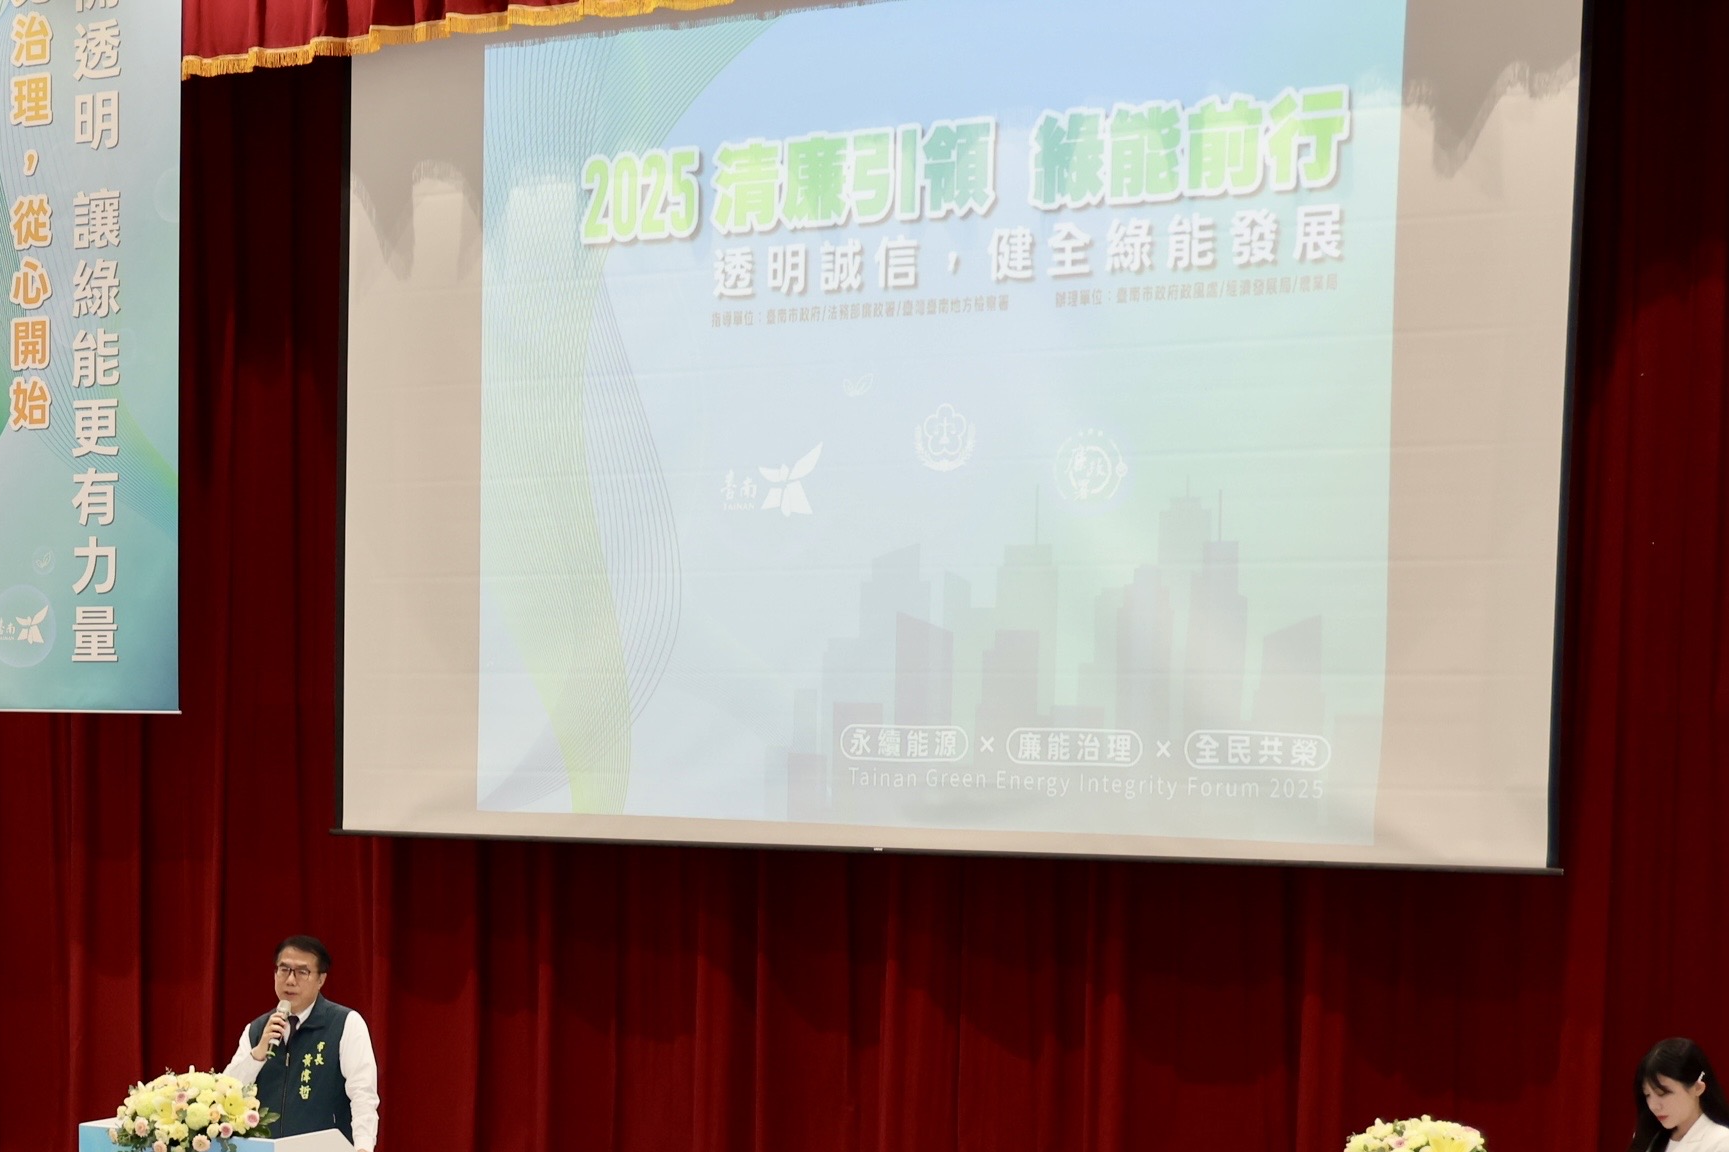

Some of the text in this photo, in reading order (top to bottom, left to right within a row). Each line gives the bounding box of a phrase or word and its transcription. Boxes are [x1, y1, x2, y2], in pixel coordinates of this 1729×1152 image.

[10, 0, 53, 431] 治理，從心開始
[581, 85, 1352, 245] 2025 清廉引領 綠能前行
[713, 203, 1344, 298] 透明誠信，健全綠能發展
[71, 0, 122, 664] 透明 讓綠能更有力量
[848, 766, 1325, 800] Tainan Green Energy Integrity Forum 2025
[850, 728, 960, 758] 永續能源
[1017, 732, 1132, 763] 廉能治理
[1195, 734, 1319, 767] 全民共榮
